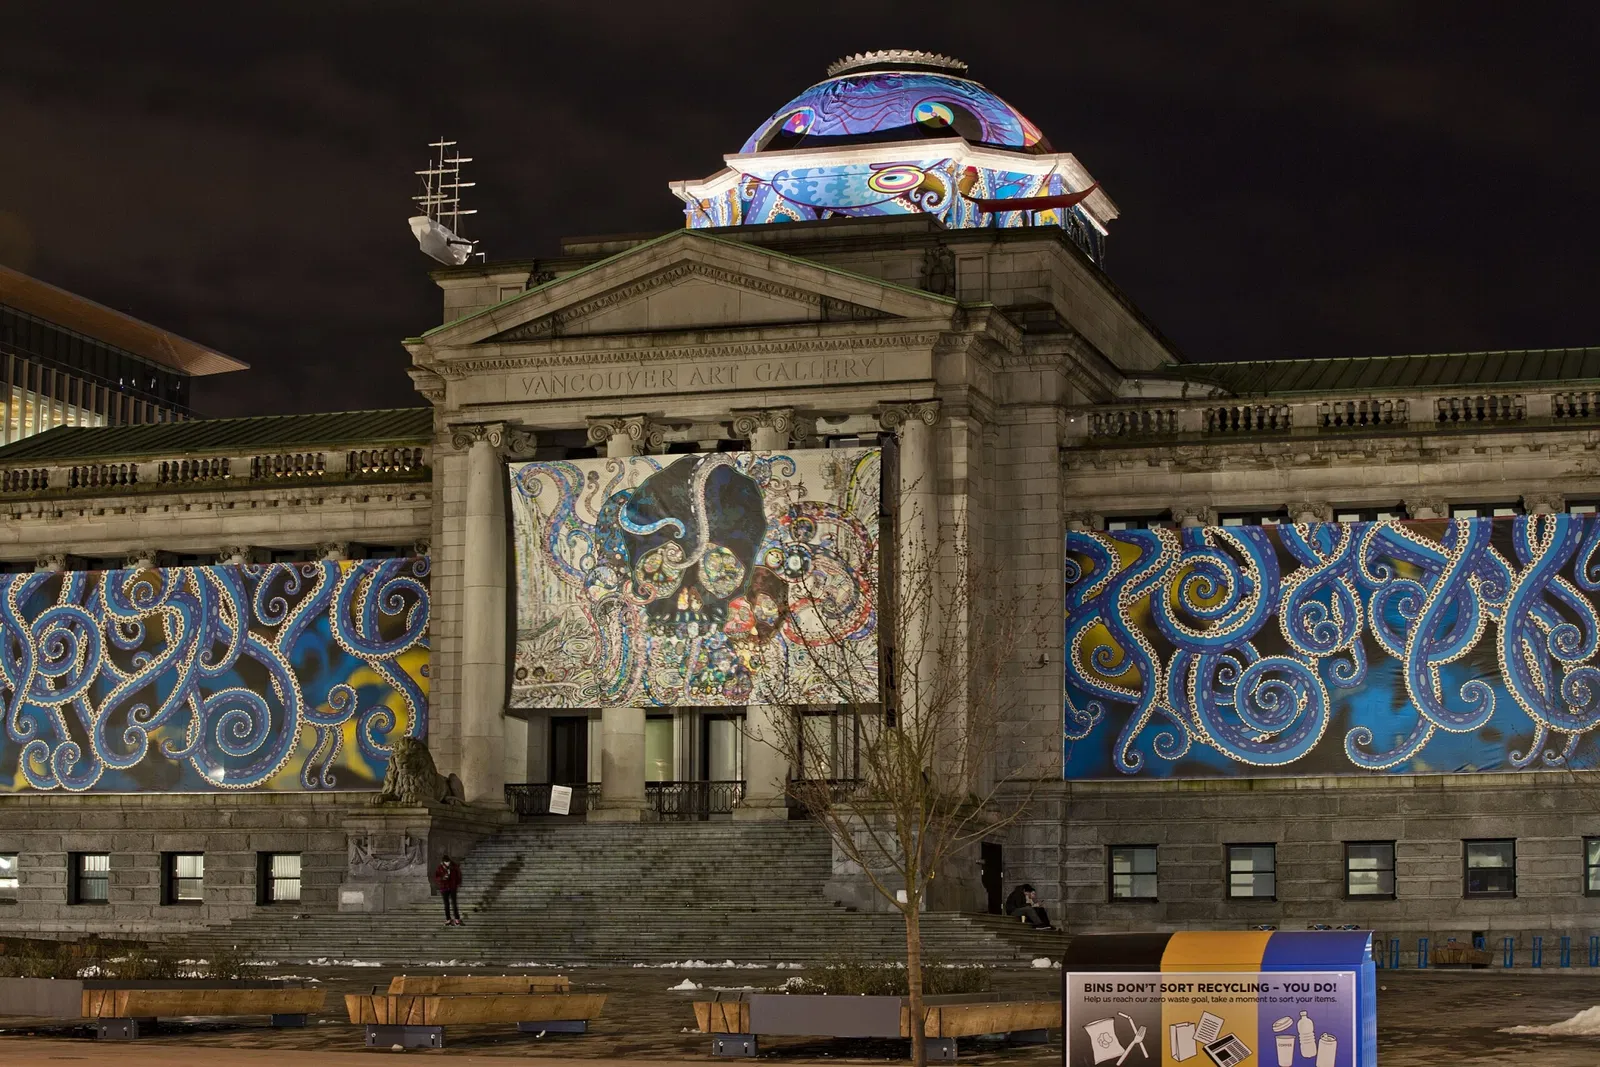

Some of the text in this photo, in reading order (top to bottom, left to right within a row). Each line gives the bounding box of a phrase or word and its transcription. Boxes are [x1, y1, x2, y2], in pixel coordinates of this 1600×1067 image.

[522, 356, 875, 395] VANCOUVER ART GALLERY
[1084, 983, 1113, 993] BINS
[1117, 983, 1156, 993] DON’T
[1160, 983, 1194, 993] SORT
[1197, 983, 1269, 993] RECYCLING
[1283, 983, 1310, 993] YOU
[1314, 983, 1337, 993] DO!
[1084, 996, 1101, 1004] Help
[1113, 995, 1133, 1003] reach
[1191, 995, 1210, 1004] goal,
[1211, 995, 1227, 1003] take
